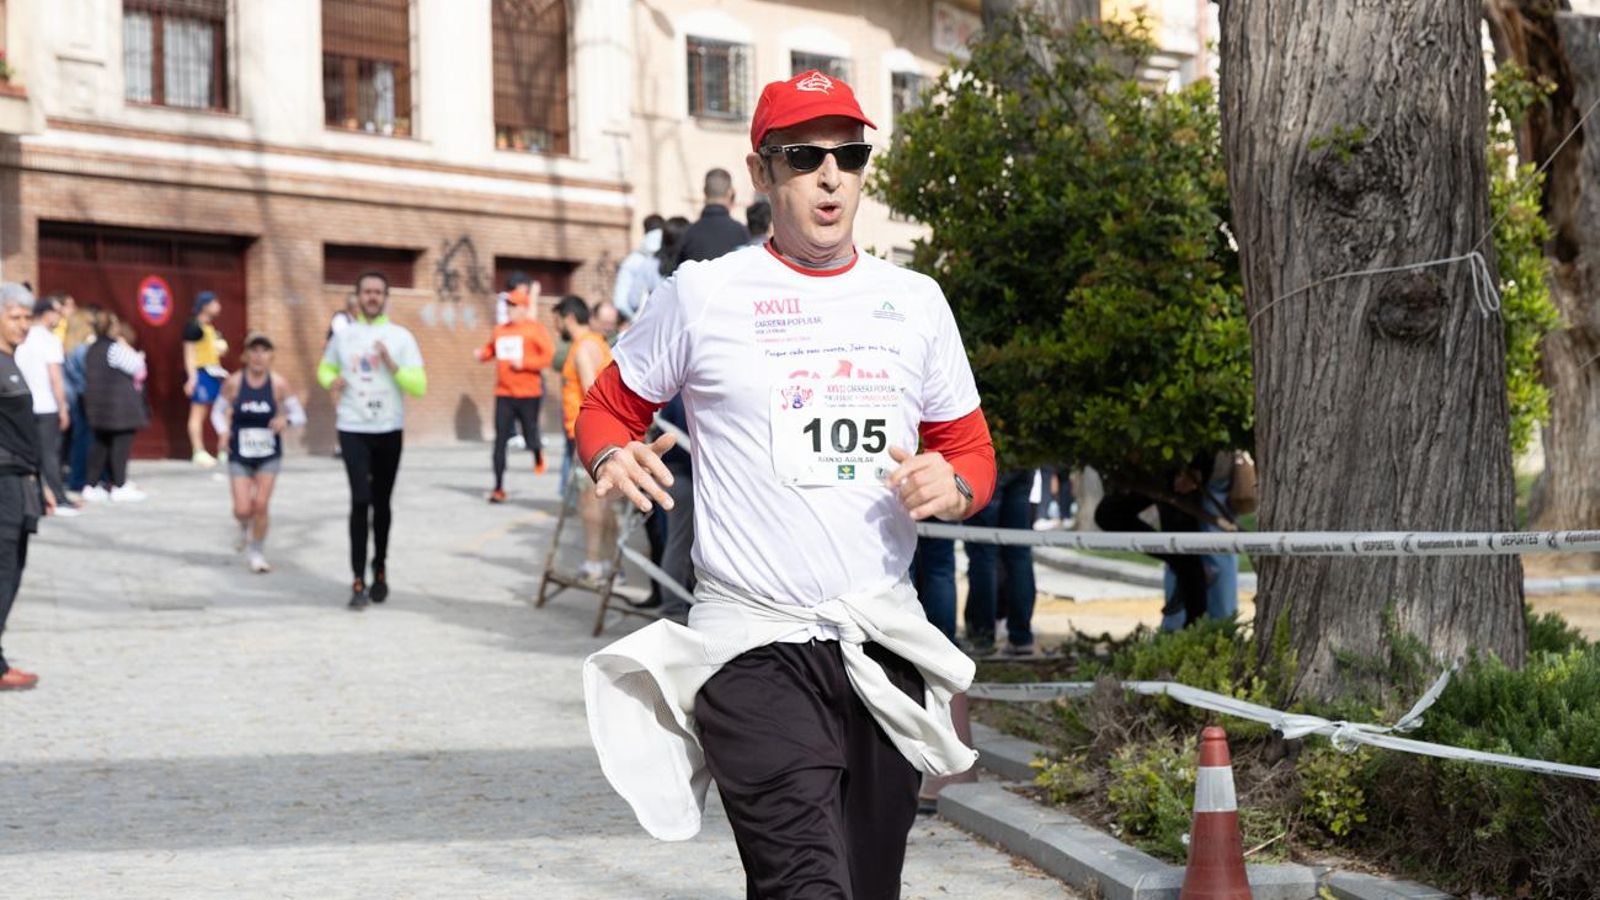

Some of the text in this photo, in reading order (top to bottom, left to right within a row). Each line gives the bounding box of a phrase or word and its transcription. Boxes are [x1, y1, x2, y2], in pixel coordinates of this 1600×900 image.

[753, 299, 801, 316] XXVII
[787, 316, 822, 326] POPULAR
[803, 418, 887, 454] 105
[844, 455, 875, 464] AGUILAR
[1362, 540, 1396, 551] DEPORTES
[1501, 533, 1539, 546] DEPORTES
